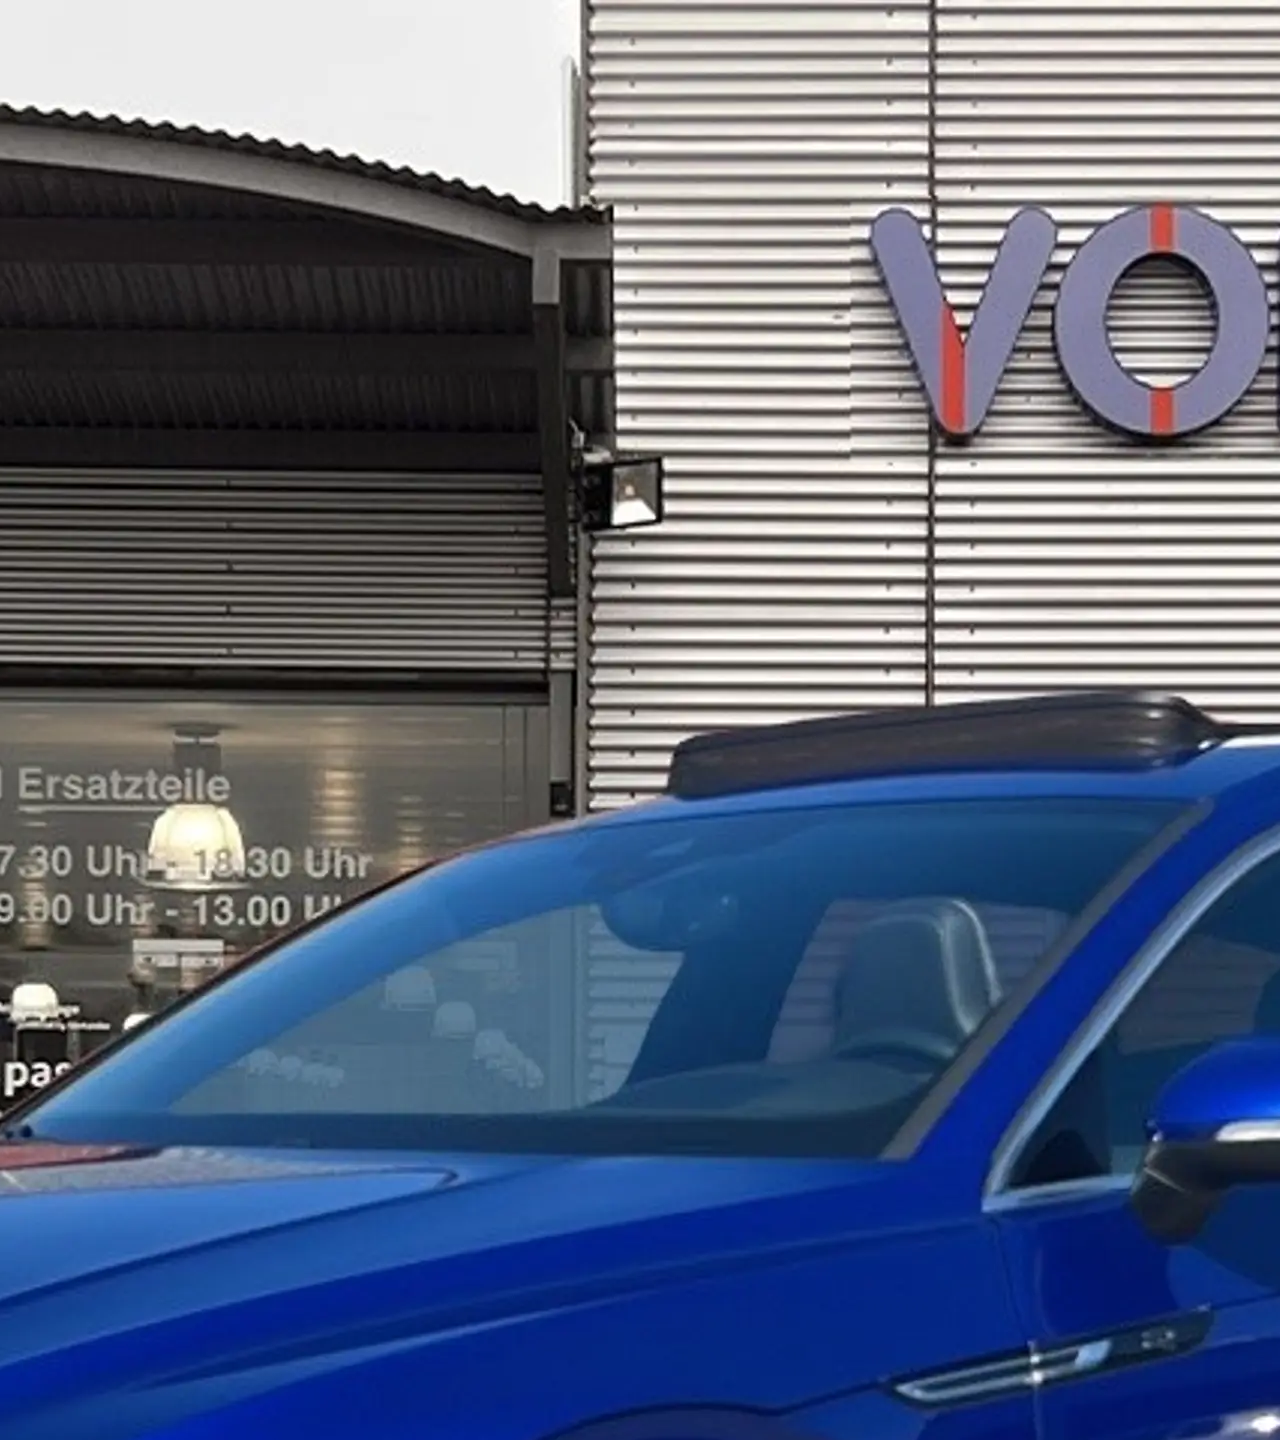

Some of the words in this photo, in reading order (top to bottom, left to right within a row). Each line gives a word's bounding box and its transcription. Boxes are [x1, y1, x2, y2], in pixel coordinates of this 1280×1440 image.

[18, 766, 232, 801] Ersatzteile
[86, 846, 153, 878] Uhr
[195, 847, 292, 879] 18.30
[304, 848, 375, 879] Uhr
[86, 893, 155, 925] Uhr
[196, 894, 292, 926] 13.00
